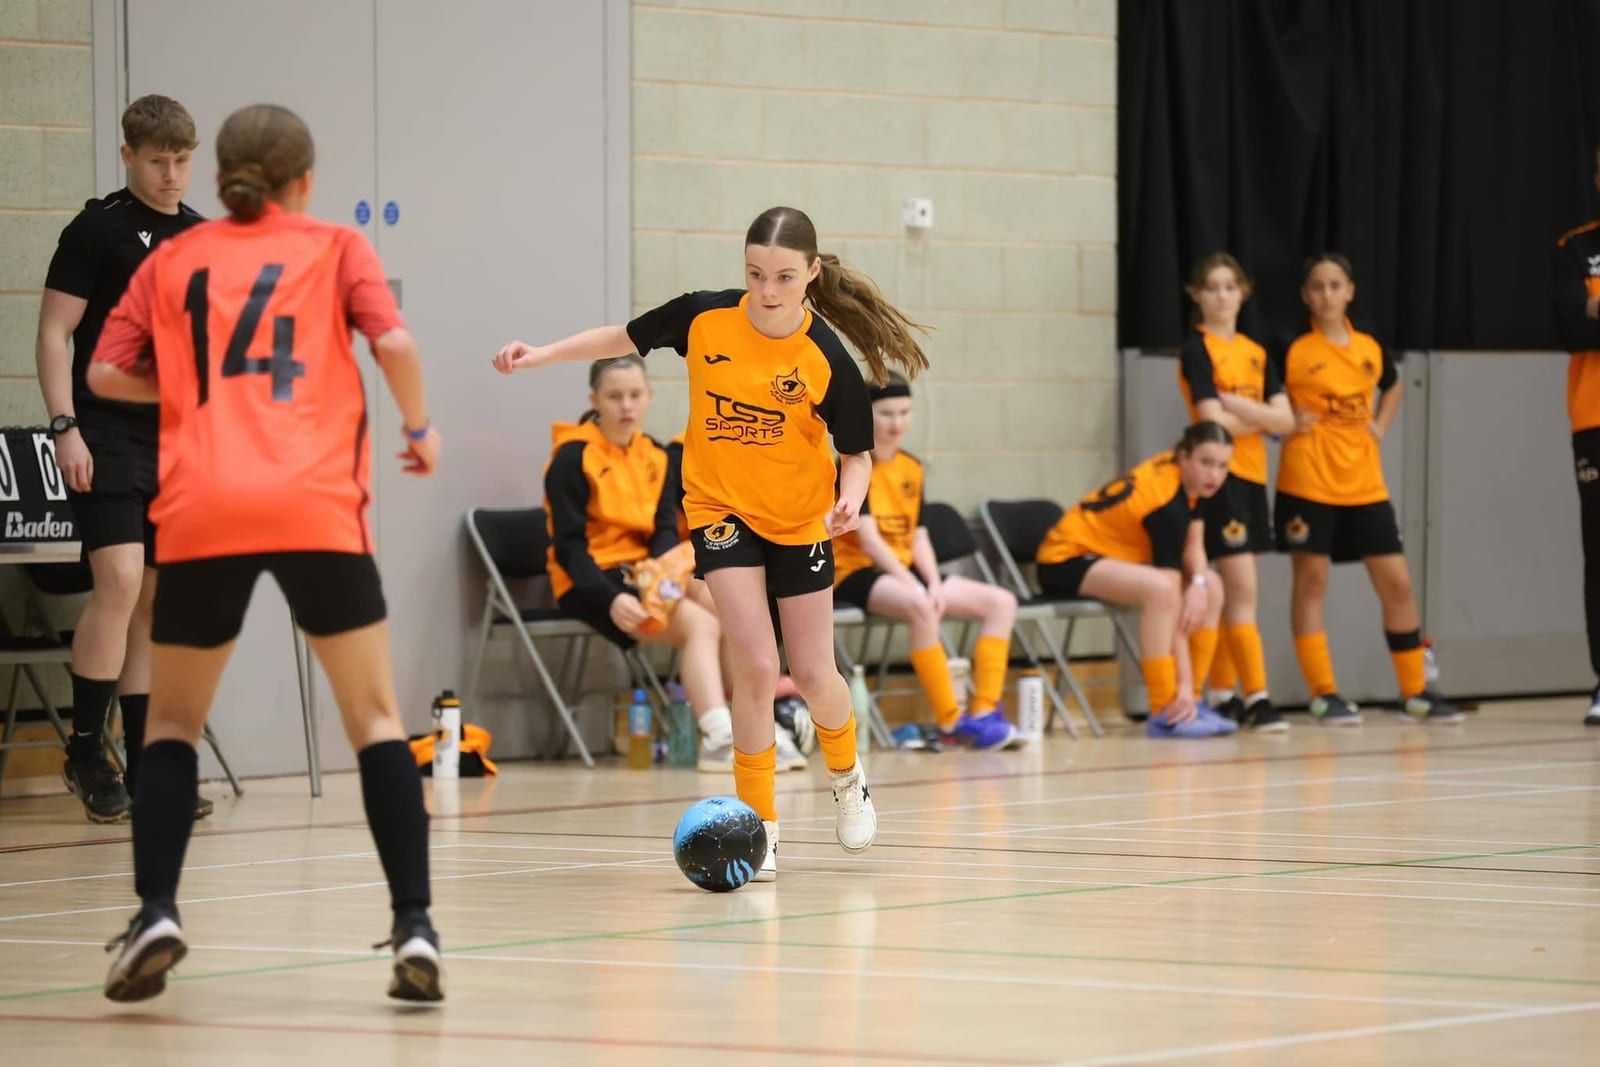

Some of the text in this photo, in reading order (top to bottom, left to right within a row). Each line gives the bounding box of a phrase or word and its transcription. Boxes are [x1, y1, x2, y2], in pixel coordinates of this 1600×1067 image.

[184, 263, 305, 409] 14
[706, 418, 784, 439] SPORTS
[5, 511, 73, 538] Baden
